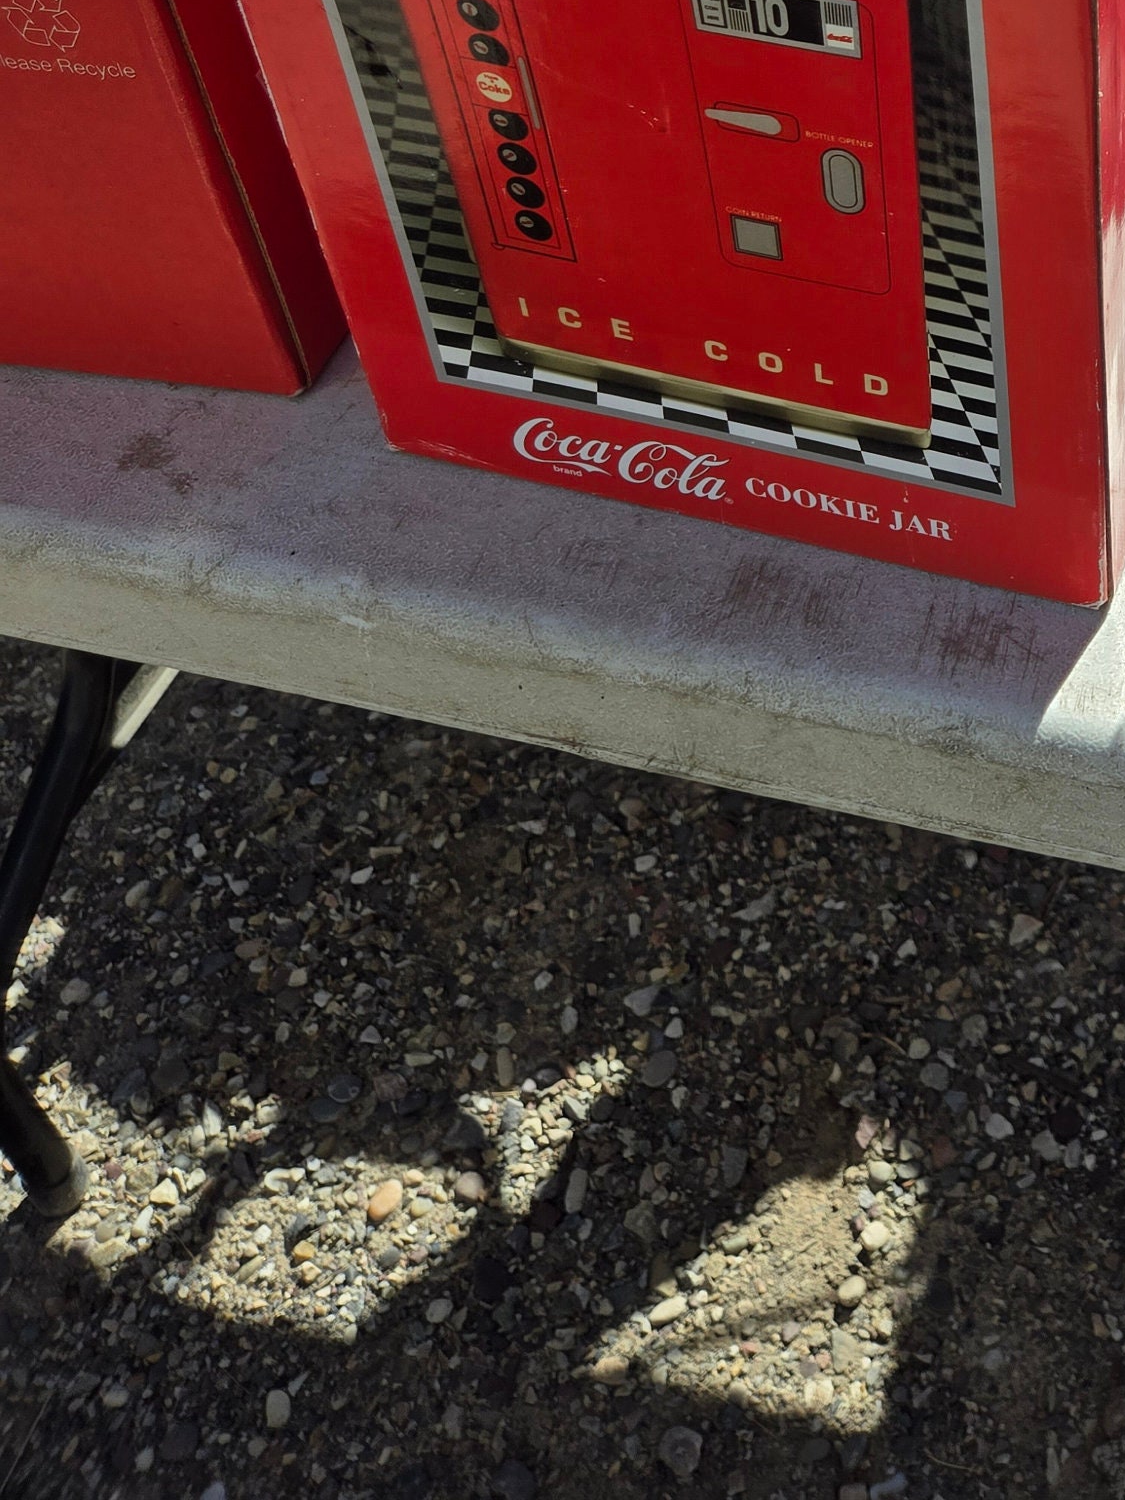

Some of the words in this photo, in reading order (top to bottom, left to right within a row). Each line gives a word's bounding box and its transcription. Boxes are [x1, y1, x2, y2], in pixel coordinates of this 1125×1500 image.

[57, 58, 137, 80] Recycle
[478, 81, 510, 96] Coke
[805, 130, 836, 143] BOTTLE
[838, 135, 874, 148] OPENER
[518, 296, 634, 341] ICE
[704, 339, 889, 398] COLD
[512, 417, 732, 503] Coca-Cola
[744, 476, 880, 525] COOKIE
[889, 510, 954, 542] JAR
[552, 463, 583, 478] brand
